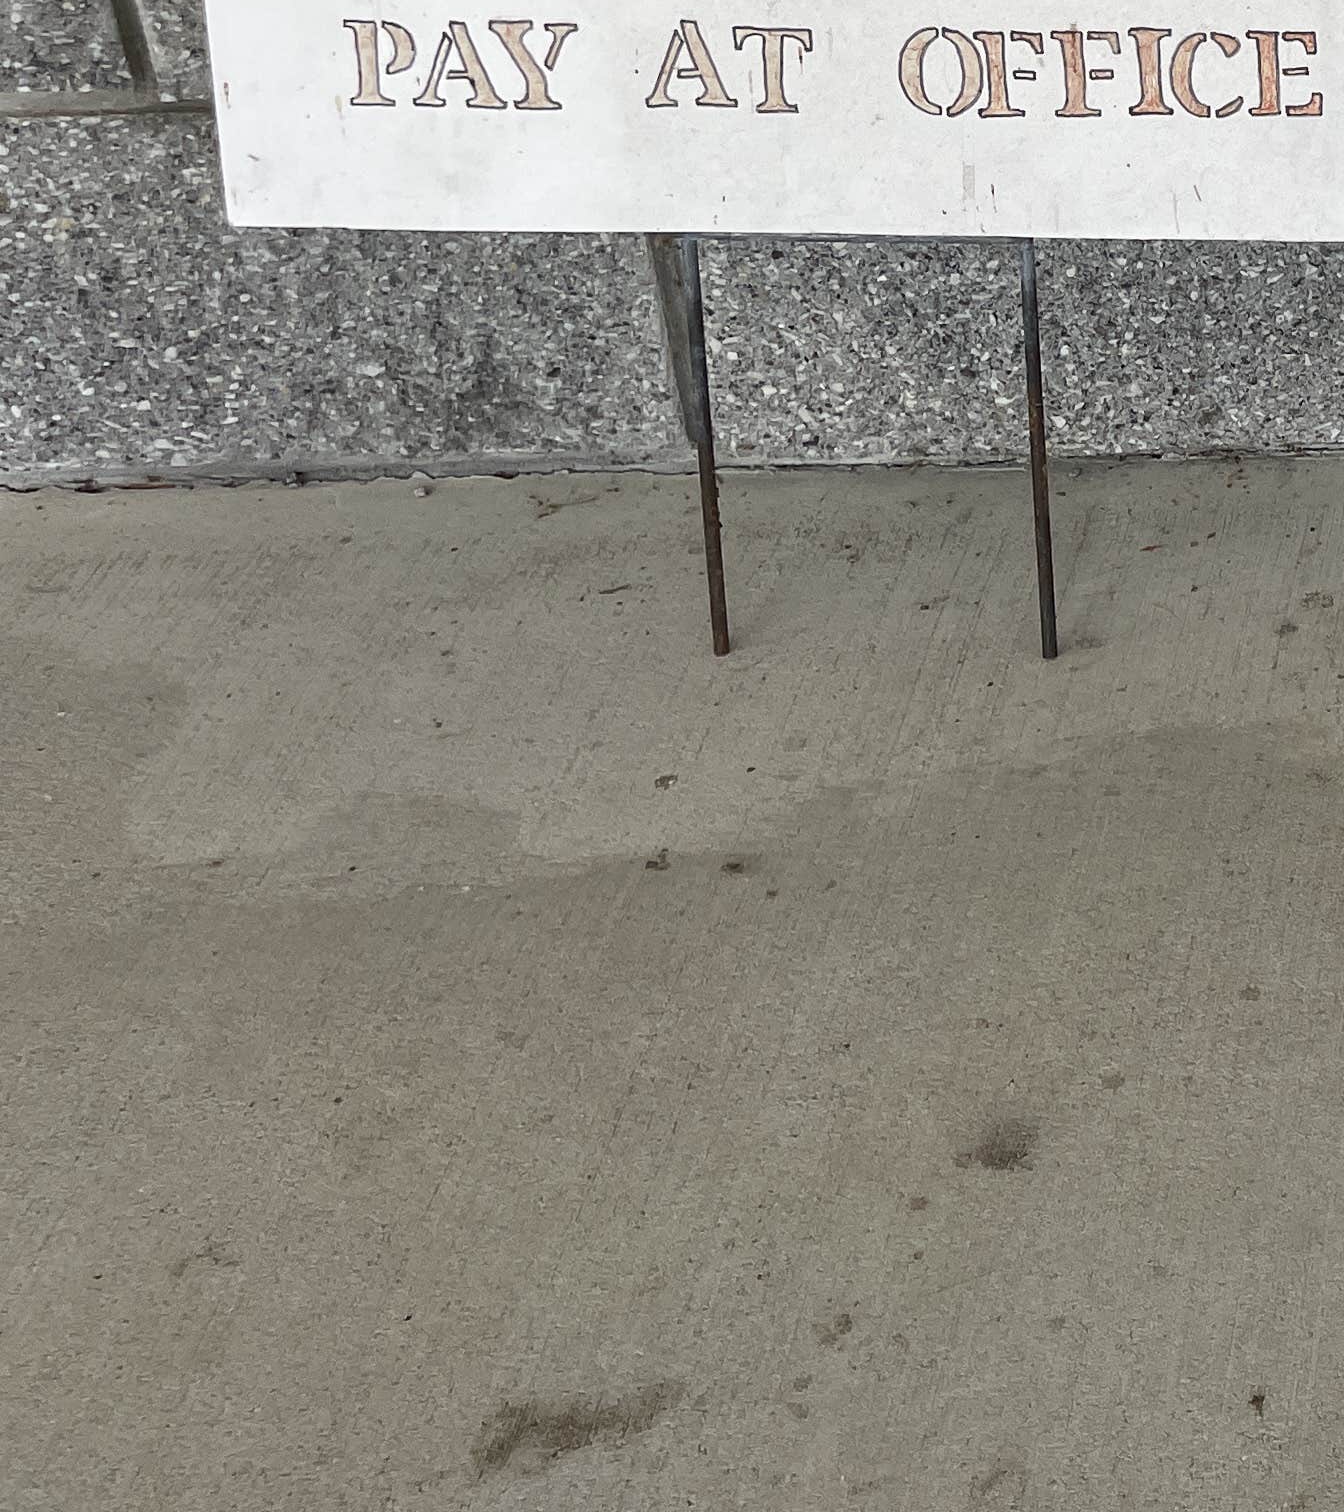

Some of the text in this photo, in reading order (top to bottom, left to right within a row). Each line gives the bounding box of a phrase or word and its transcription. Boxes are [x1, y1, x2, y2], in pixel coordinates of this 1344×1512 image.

[343, 19, 1323, 118] PAY AT OFFICE
